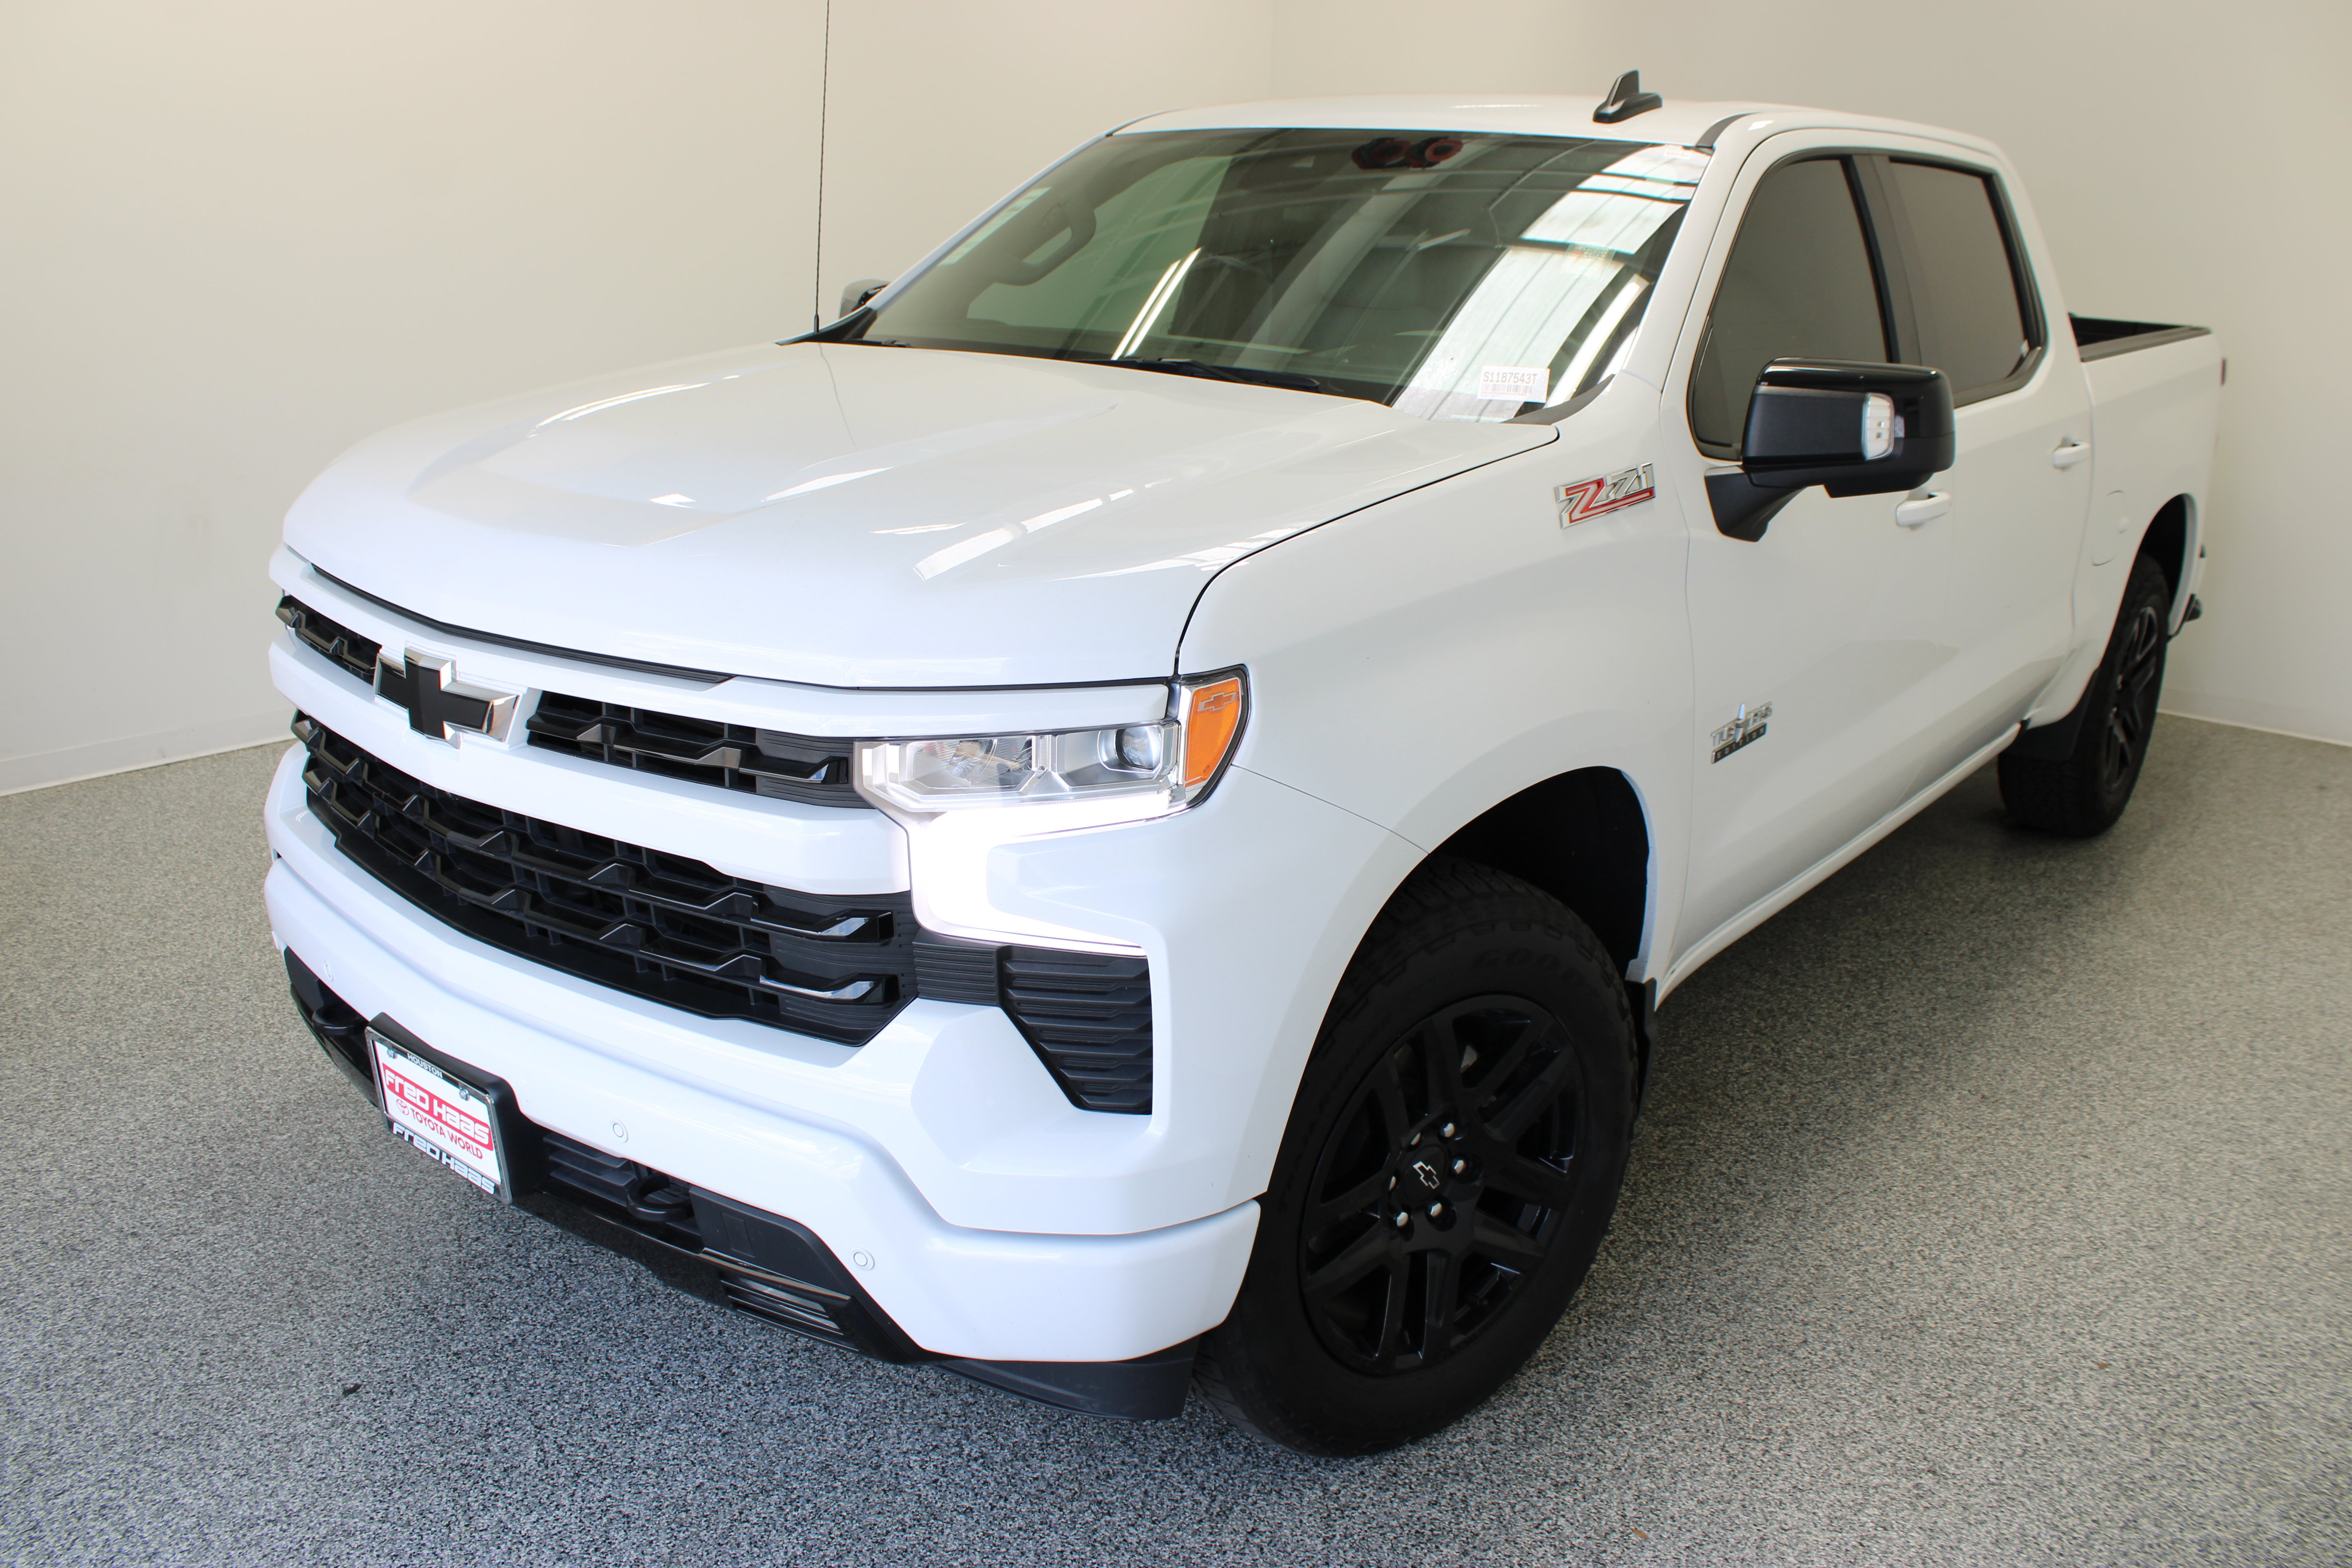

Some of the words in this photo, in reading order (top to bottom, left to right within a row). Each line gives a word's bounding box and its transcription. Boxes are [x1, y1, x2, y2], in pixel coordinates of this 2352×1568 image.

[1483, 371, 1538, 385] S1187543T
[1554, 461, 1656, 529] Z71
[1711, 701, 1773, 746] TEAS
[1717, 726, 1765, 759] EDITION
[407, 1053, 443, 1079] HOUSTON
[411, 1107, 447, 1138] TOYOTA
[448, 1129, 483, 1160] WORLD
